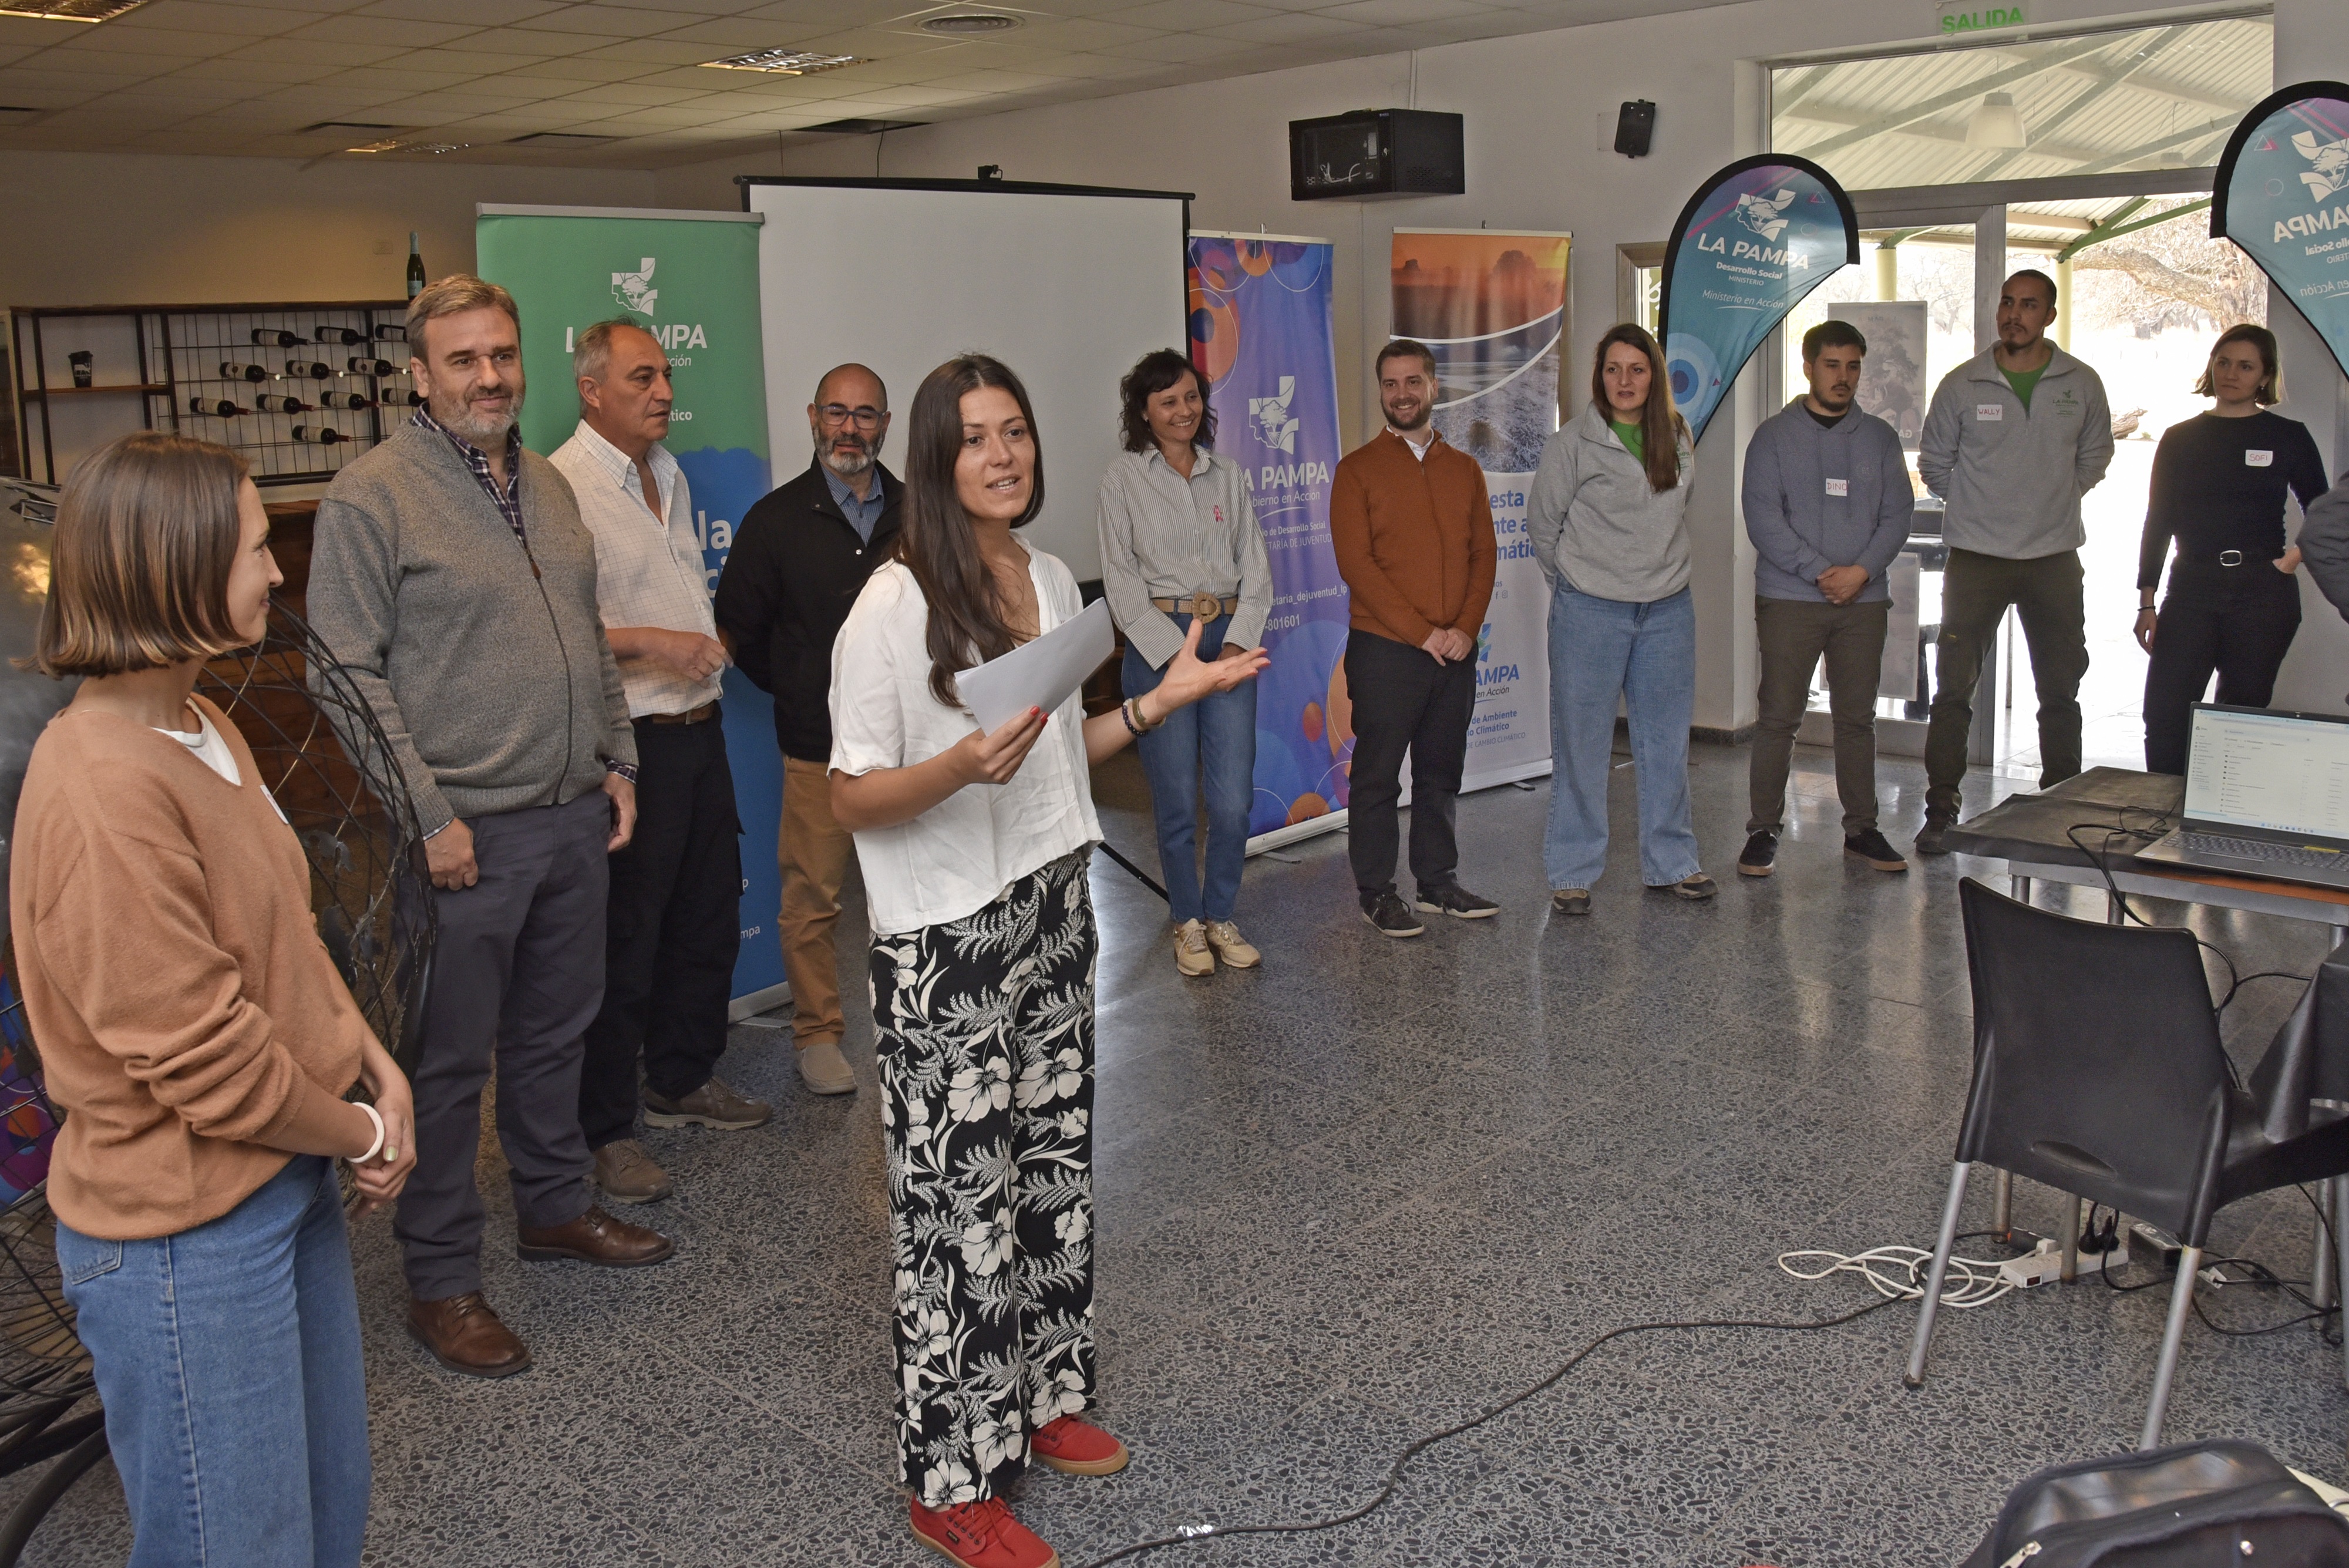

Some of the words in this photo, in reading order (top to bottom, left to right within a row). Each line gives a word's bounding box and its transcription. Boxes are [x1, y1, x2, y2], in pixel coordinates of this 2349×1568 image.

[1942, 7, 2024, 33] SALIDA
[1697, 233, 1725, 254] LA
[1732, 241, 1809, 270] PAMPA
[1716, 261, 1757, 275] Desarrollo
[1758, 270, 1782, 280] Social
[1728, 275, 1764, 286] MINISTERIO
[1702, 290, 1742, 304] Ministerio
[1756, 299, 1784, 308] Acción
[640, 324, 708, 350] MPA
[667, 354, 692, 366] ción
[1243, 468, 1255, 491] A
[1261, 461, 1330, 490] PAMPA
[1253, 495, 1279, 507] bierno
[1281, 494, 1291, 503] en
[1293, 490, 1320, 502] Acción
[1278, 523, 1309, 535] Desarrollo
[1310, 520, 1326, 531] Social
[1265, 538, 1288, 551] ETARÍA
[1290, 538, 1298, 548] DE
[1300, 533, 1332, 546] JUVENTUD
[1272, 584, 1347, 606] etaria_dejuventud_lp
[1265, 614, 1300, 631] -801601
[1476, 664, 1520, 687] AMPA
[1476, 690, 1485, 698] en
[1486, 685, 1510, 697] Acción
[1472, 715, 1480, 724] de
[1482, 709, 1517, 722] Ambiente
[1476, 722, 1510, 735] Climático
[1475, 738, 1496, 748] CAMBIO
[1497, 732, 1526, 743] CLIMÁTICO
